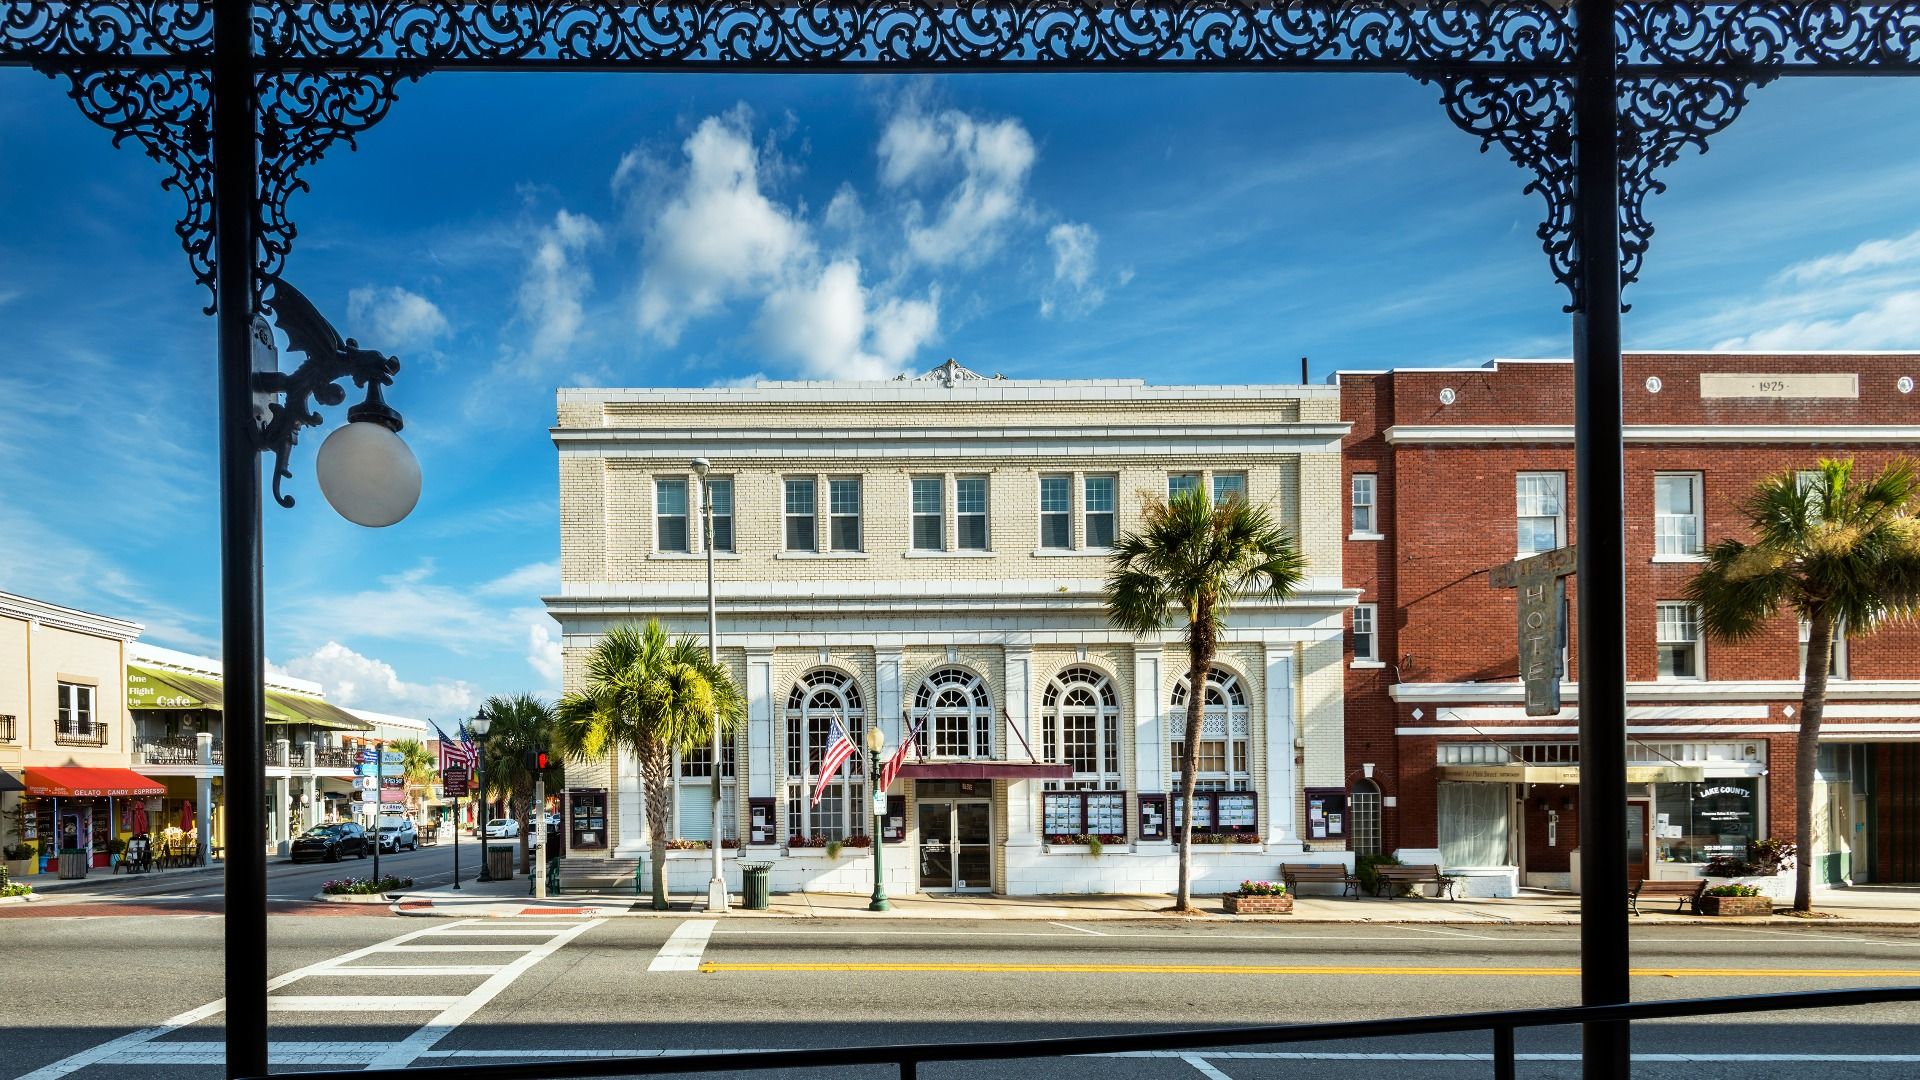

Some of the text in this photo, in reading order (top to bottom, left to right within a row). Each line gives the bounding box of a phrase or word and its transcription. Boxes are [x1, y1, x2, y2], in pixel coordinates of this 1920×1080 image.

[1760, 381, 1784, 392] 1925
[1526, 584, 1547, 707] HOTEL
[129, 674, 147, 683] One
[129, 687, 154, 697] Flight
[129, 698, 142, 706] Up
[1700, 786, 1750, 798] LAKE COUNTY
